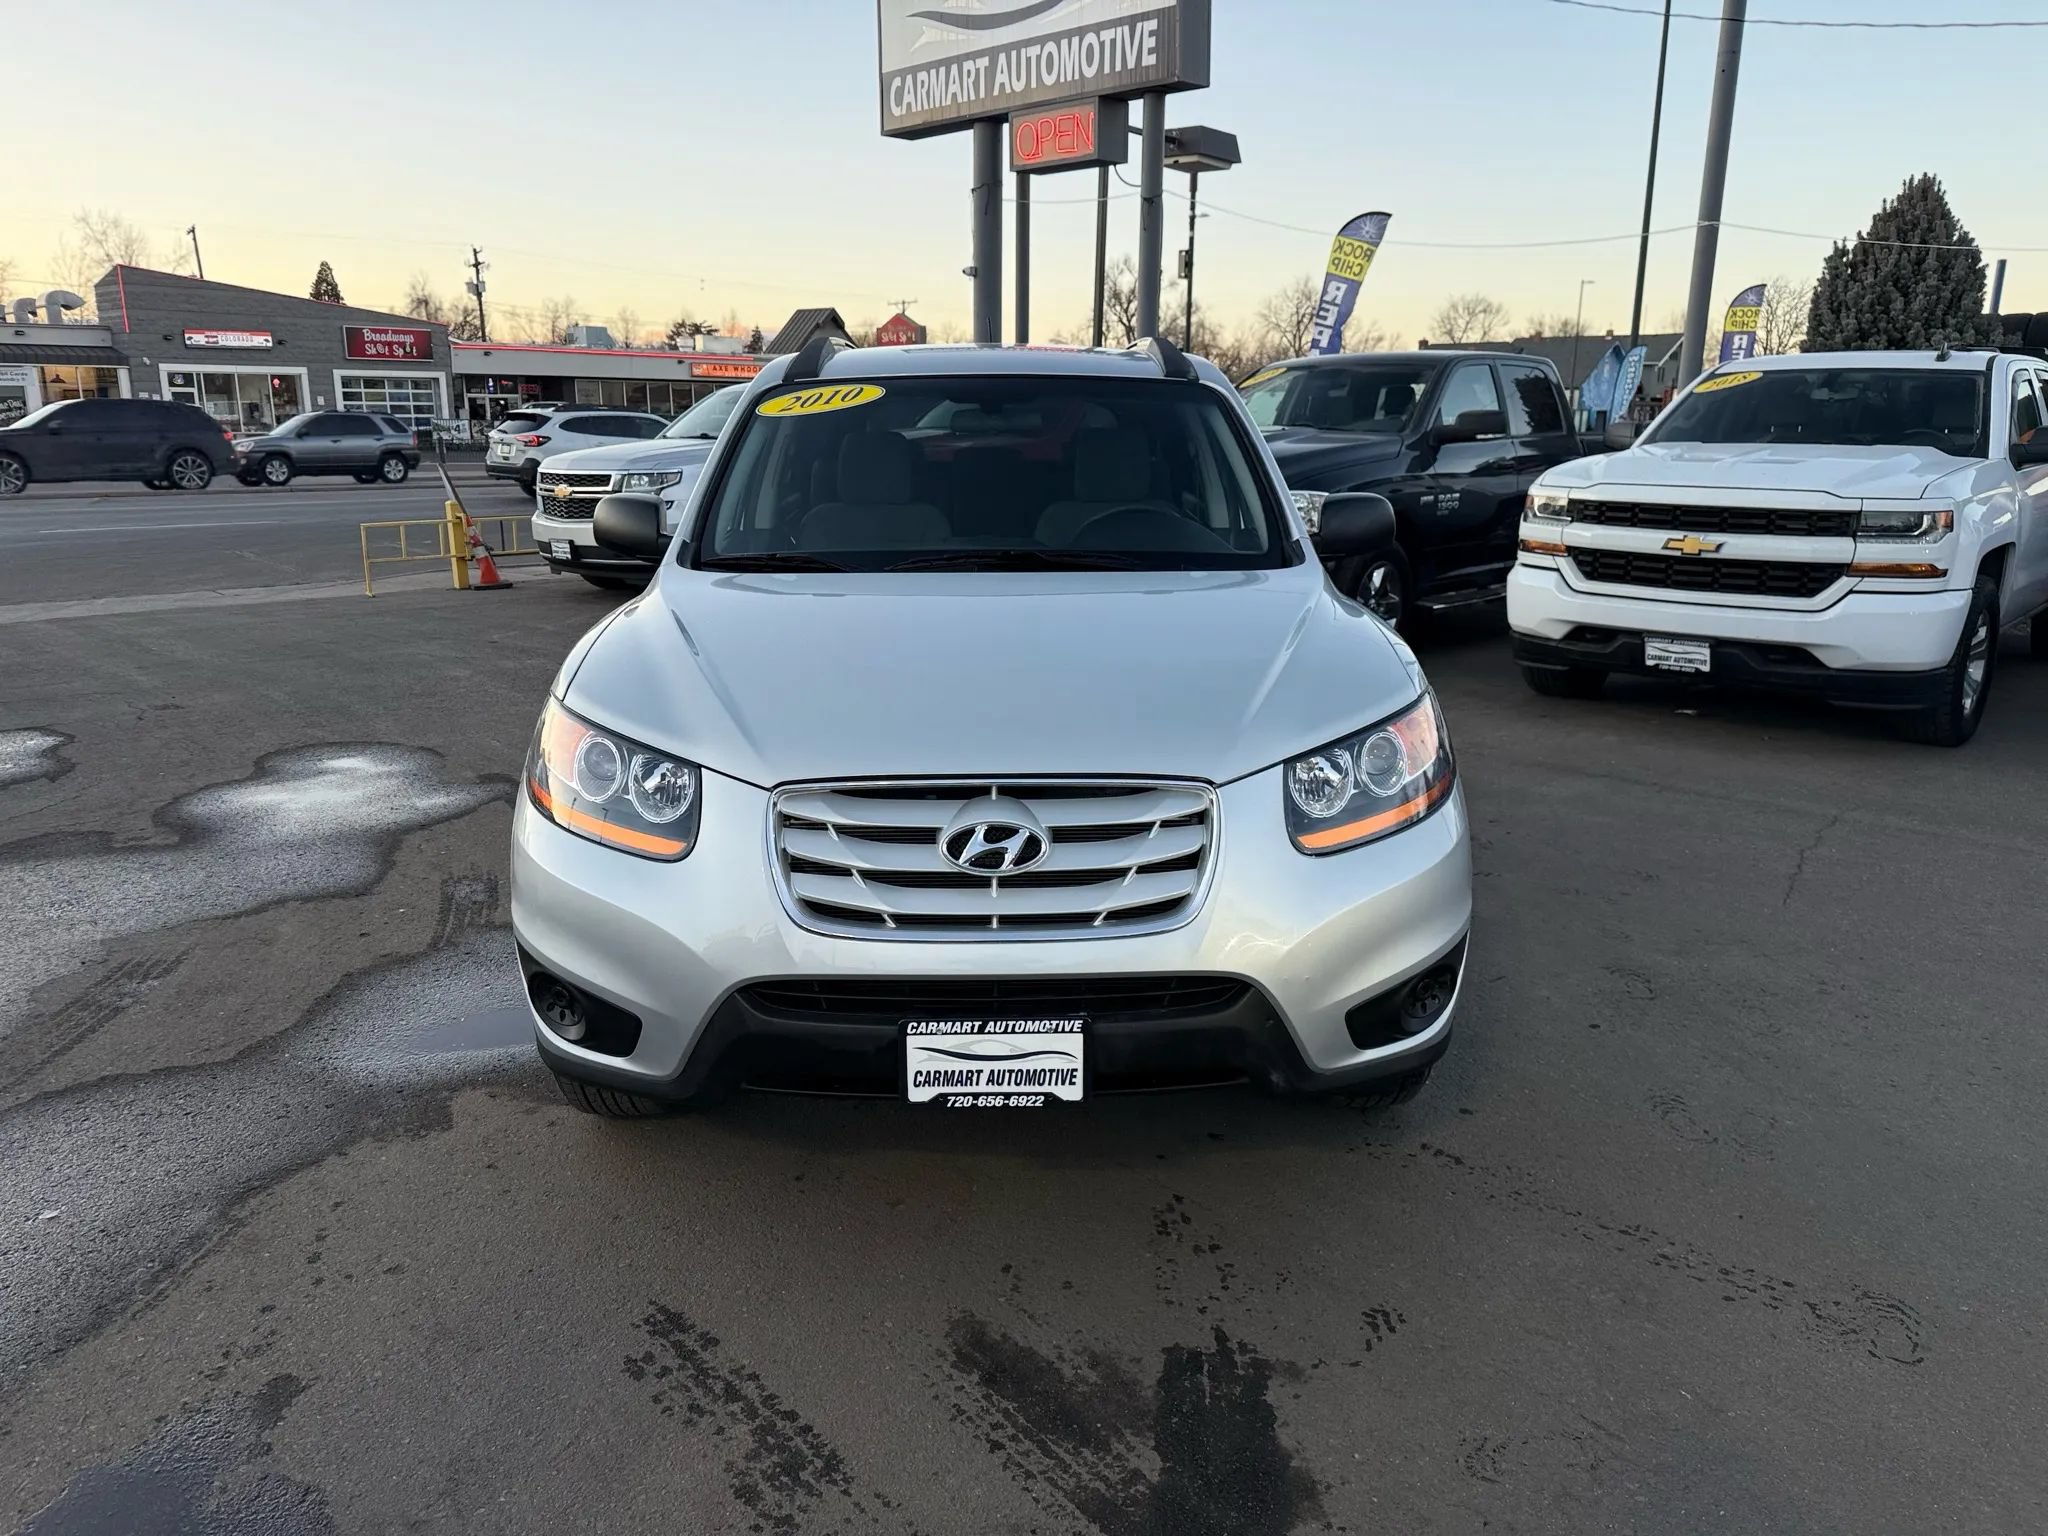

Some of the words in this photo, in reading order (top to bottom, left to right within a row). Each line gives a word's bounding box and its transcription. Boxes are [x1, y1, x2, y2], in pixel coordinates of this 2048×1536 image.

[889, 55, 989, 117] CARMART
[993, 18, 1158, 97] AUTOMOTIVE
[1016, 112, 1095, 160] OPEN
[220, 335, 254, 343] COLORADO
[776, 386, 864, 413] 2010
[1438, 493, 1461, 501] RAM
[1437, 501, 1460, 510] 1500
[1647, 653, 1673, 662] CARMART
[1673, 656, 1708, 666] AUTOMOTIVE
[906, 1020, 983, 1035] CARMART
[984, 1019, 1084, 1034] AUTOMOTIVE
[912, 1069, 984, 1088] CARMART
[985, 1068, 1079, 1087] AUTOMOTIVE
[946, 1095, 1045, 1108] 720-656-6922
